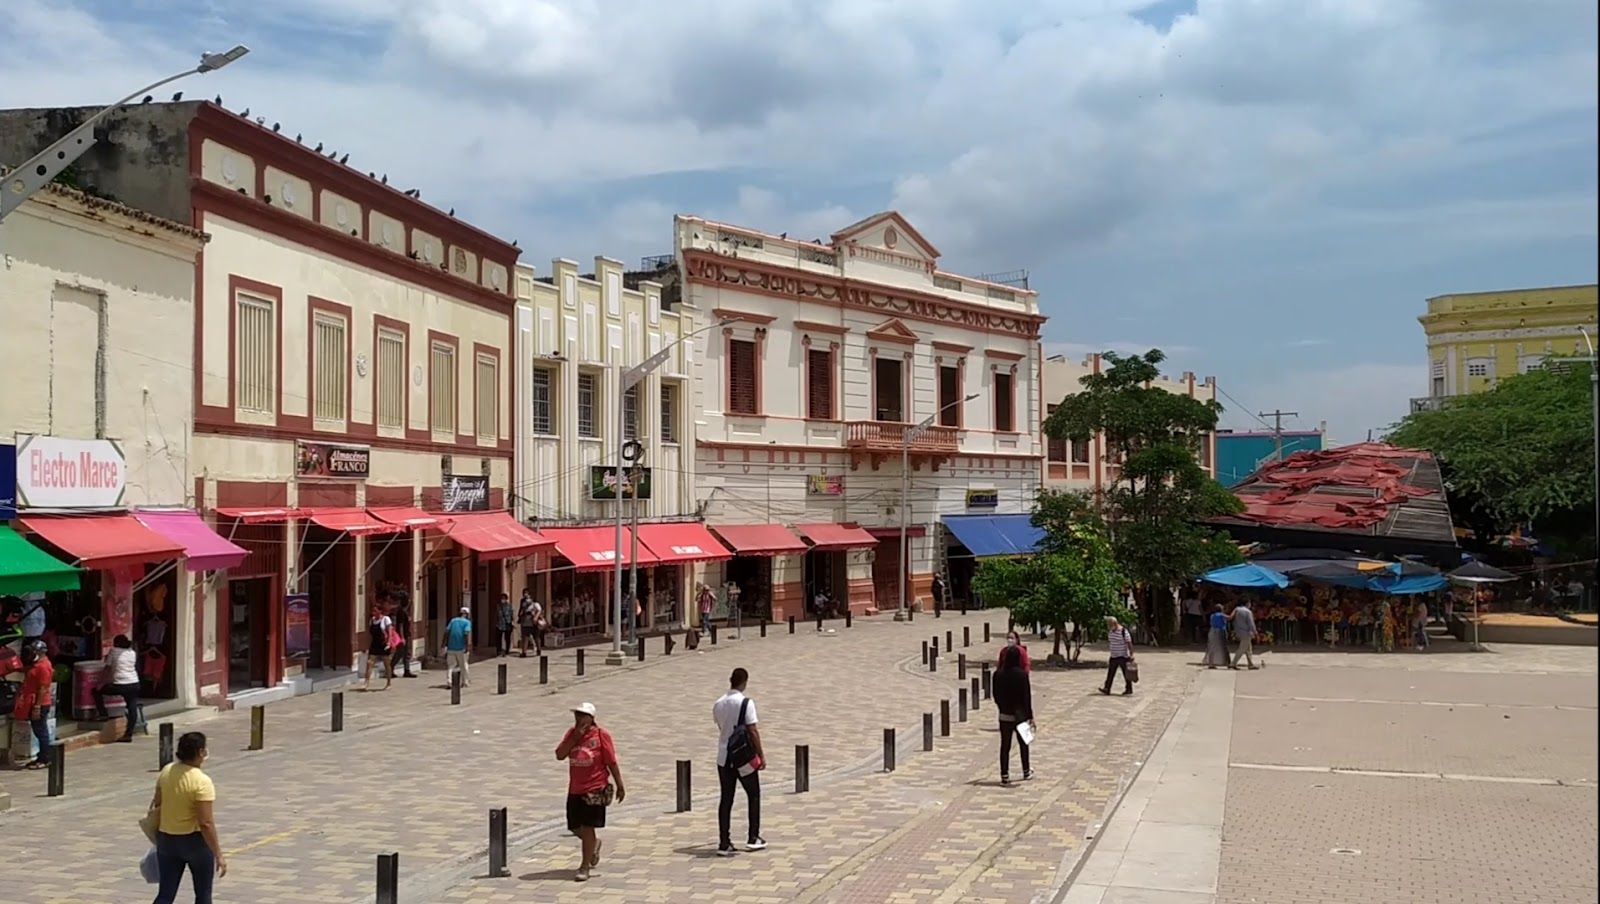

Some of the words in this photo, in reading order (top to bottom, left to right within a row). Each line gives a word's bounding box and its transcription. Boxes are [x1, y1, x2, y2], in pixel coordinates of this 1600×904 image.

[30, 449, 76, 488] Electro
[80, 451, 118, 489] Marce
[447, 478, 486, 511] Joseph
